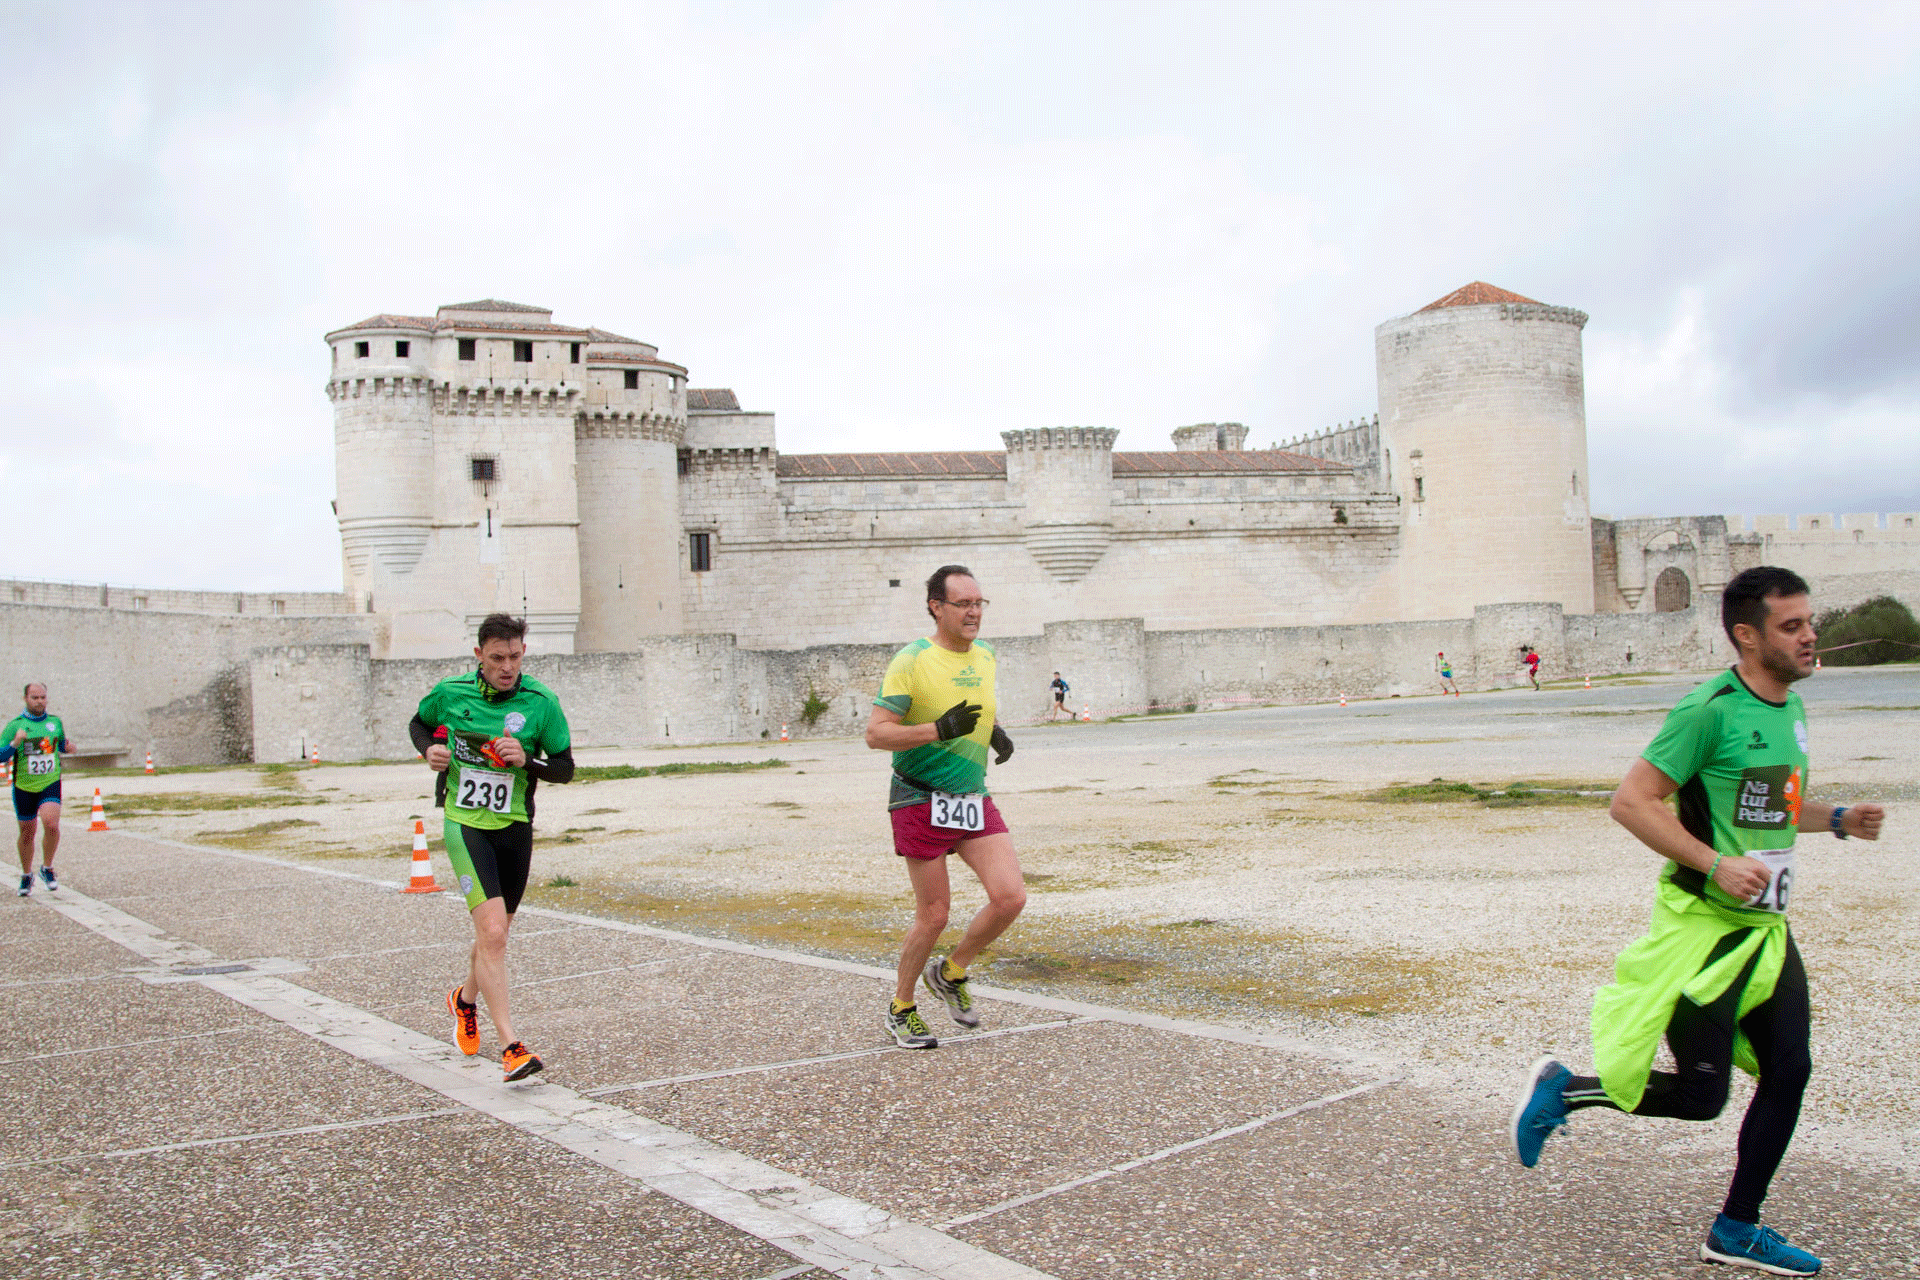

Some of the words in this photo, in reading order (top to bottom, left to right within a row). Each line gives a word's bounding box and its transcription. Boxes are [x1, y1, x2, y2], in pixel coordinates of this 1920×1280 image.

[31, 760, 53, 774] 232
[461, 779, 508, 811] 239
[1743, 780, 1769, 795] Na
[1740, 793, 1770, 808] tur
[936, 799, 978, 829] 340
[1737, 807, 1775, 823] Pellet
